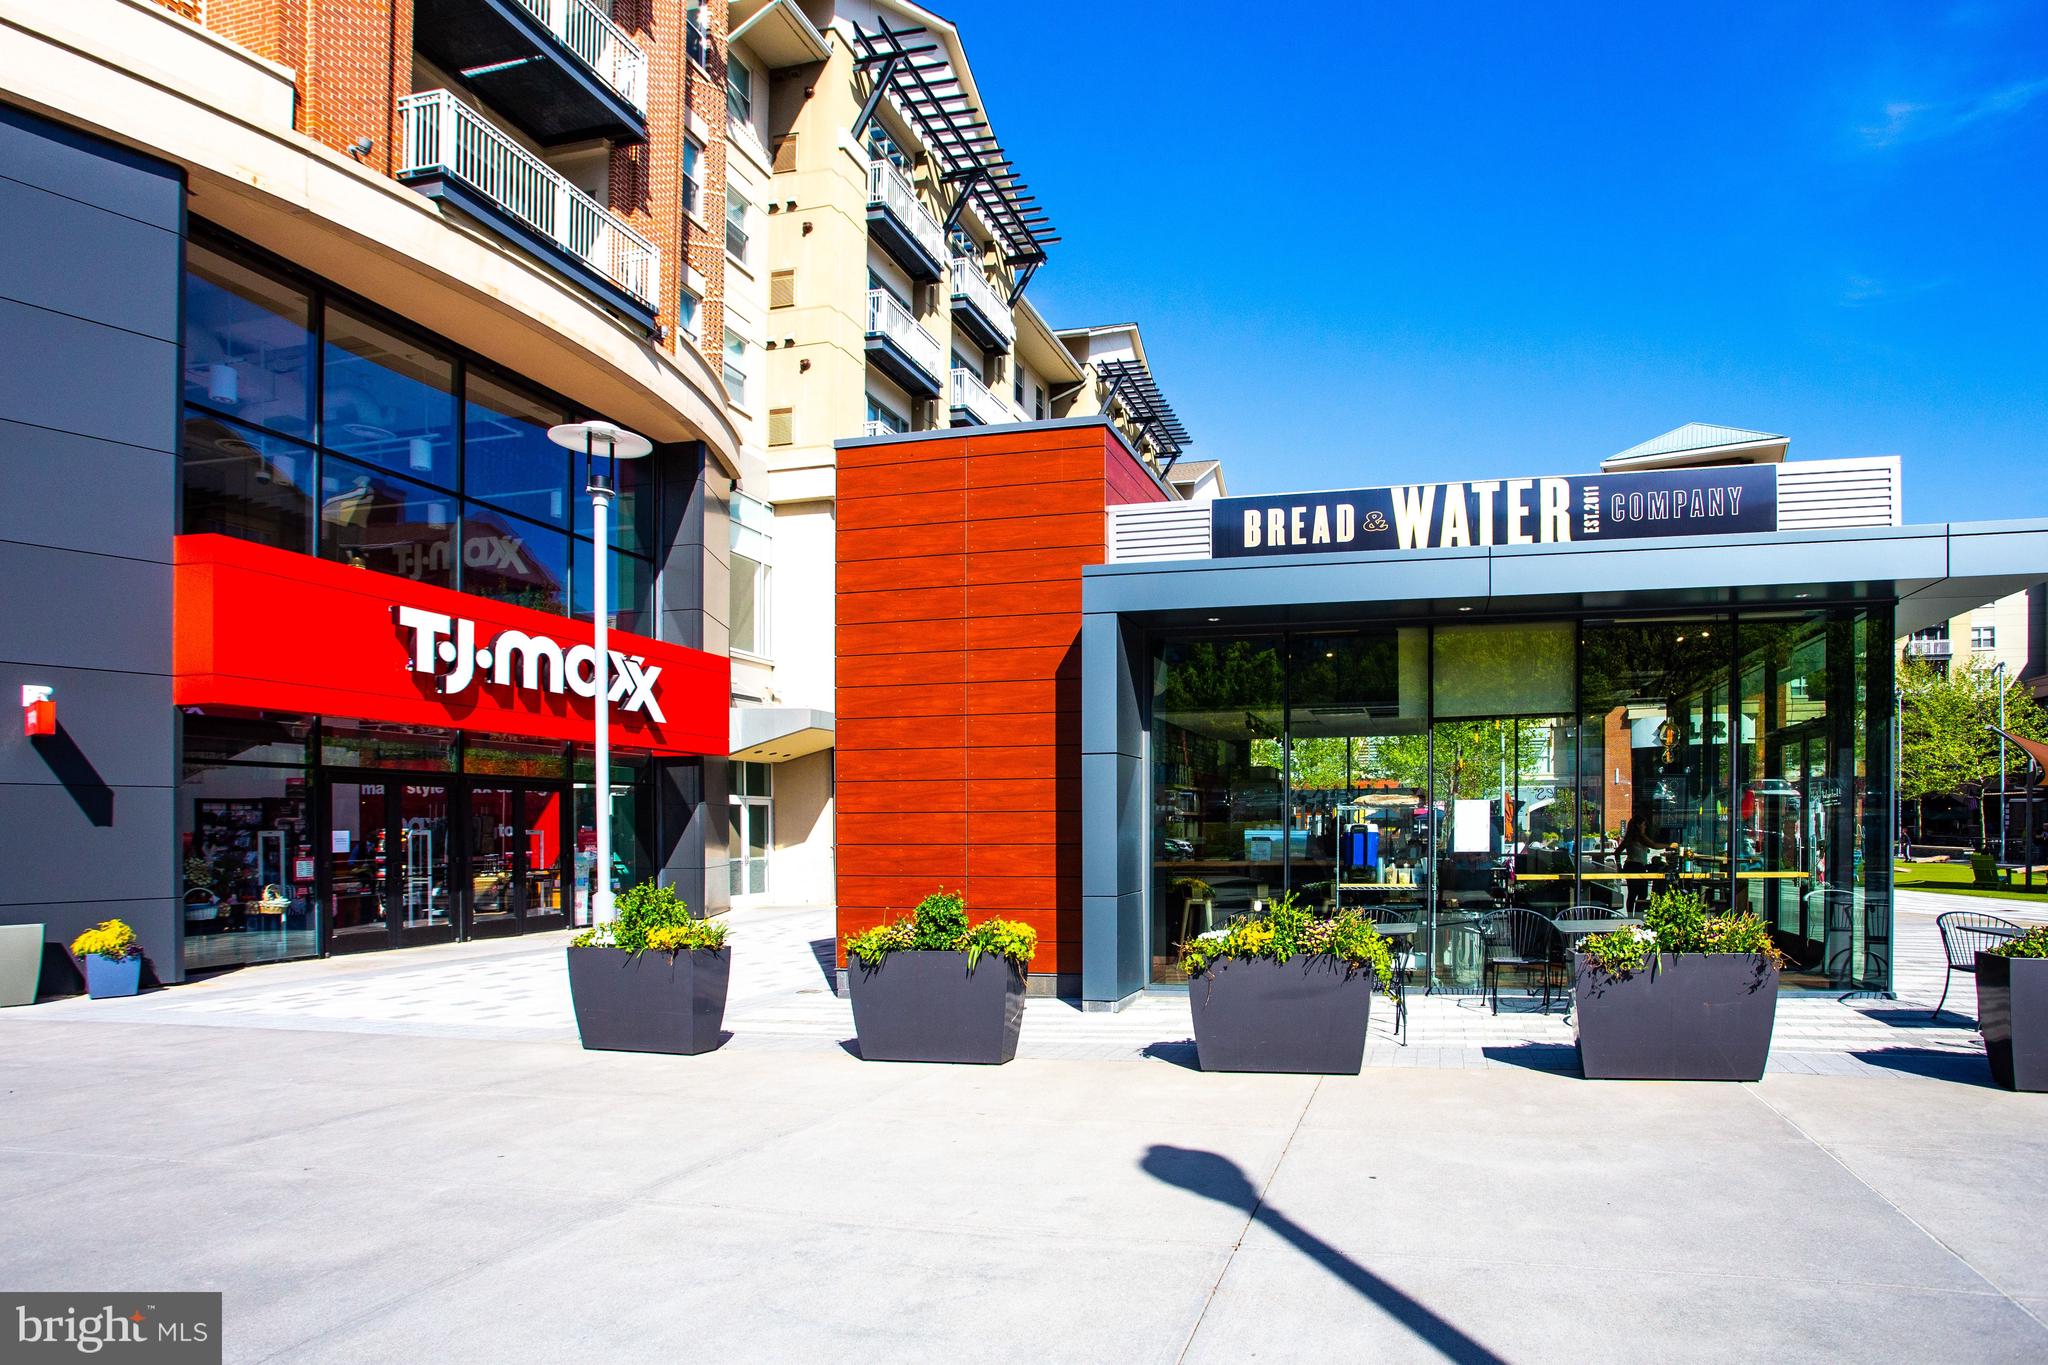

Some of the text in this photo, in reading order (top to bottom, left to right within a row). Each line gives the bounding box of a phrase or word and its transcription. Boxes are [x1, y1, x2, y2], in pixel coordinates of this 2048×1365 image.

[1243, 477, 1743, 549] BREAD & WATER COMPANY
